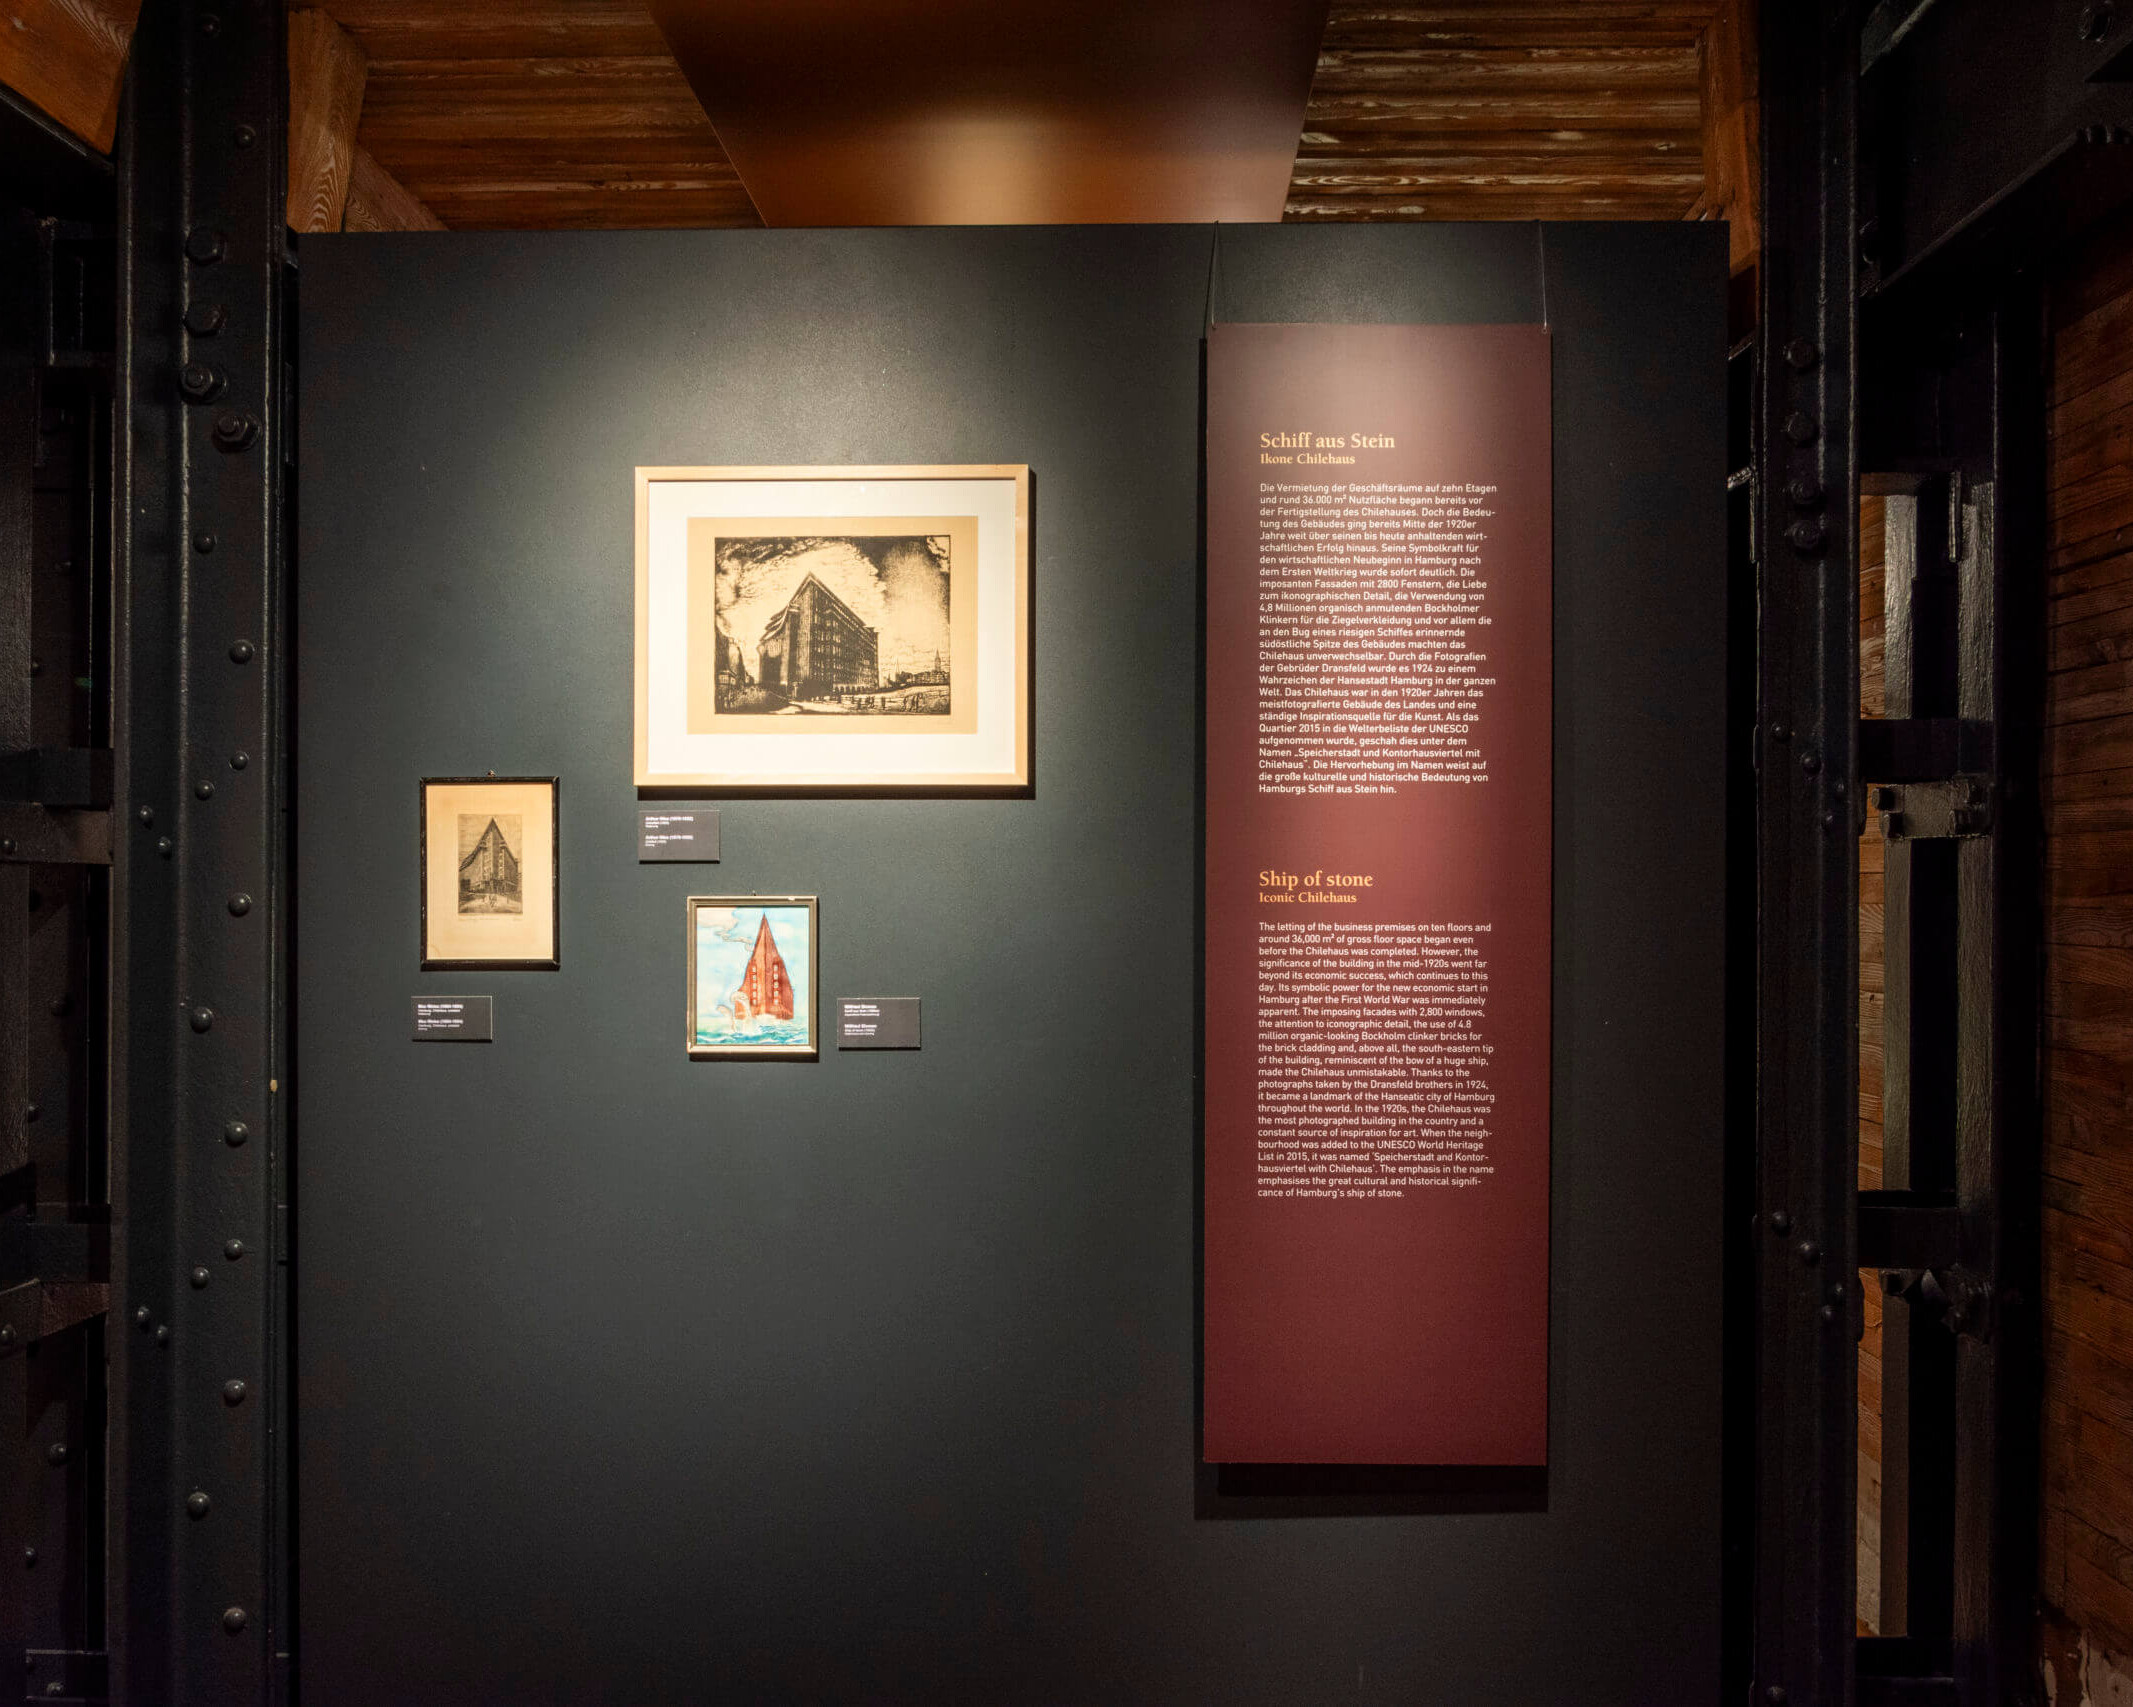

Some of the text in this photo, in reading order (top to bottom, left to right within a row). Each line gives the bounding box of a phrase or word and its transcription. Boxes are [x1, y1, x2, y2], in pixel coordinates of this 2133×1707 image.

[1260, 432, 1395, 448] Schiff aus Stein
[1260, 454, 1356, 465] Ikone Chilehaus
[1260, 483, 1497, 495] Die Vermietung der Geschäftsräume auf zehn Etagen
[1259, 507, 1275, 517] der
[1277, 507, 1341, 519] Fertigstellung
[1343, 507, 1359, 517] des
[1361, 507, 1418, 517] Chilehauses.
[1421, 507, 1444, 517] Doch
[1446, 507, 1460, 517] die
[1260, 531, 1286, 541] Jahre
[1287, 531, 1306, 541] weit
[1309, 531, 1330, 541] über
[1332, 531, 1362, 541] seinen
[1364, 531, 1377, 541] bis
[1379, 531, 1405, 541] heute
[1407, 531, 1464, 541] anhaltenden
[1259, 555, 1481, 567] den wirtschaftlichen Neubeginn in Hamburg nach
[1259, 579, 1487, 591] imposanten Fassaden mit 2800 Fenstern, die Liebe
[1275, 603, 1317, 613] Millionen
[1319, 603, 1363, 615] organisch
[1365, 603, 1422, 613] anmutenden
[1259, 640, 1466, 651] südöstliche Spitze des Gebäudes machten das
[1259, 664, 1275, 673] der
[1277, 664, 1319, 673] Gebrüder
[1322, 664, 1366, 673] Dransfeld
[1368, 664, 1397, 673] wurde
[1413, 664, 1433, 673] 1924
[1448, 664, 1476, 673] einem
[1259, 676, 1496, 688] Wahrzeichen der Hansestadt Hamburg in der ganzen
[1259, 724, 1469, 733] Quartier 2015 in die Welterbeliste der UNESCO
[1259, 870, 1373, 891] Ship of stone
[1259, 892, 1357, 903] Iconic Chilehaus
[1259, 923, 1275, 932] The
[1277, 923, 1305, 934] letting
[1307, 923, 1316, 932] of
[1318, 923, 1332, 932] the
[1334, 923, 1373, 932] business
[1375, 923, 1416, 934] premises
[1431, 923, 1445, 932] ten
[1447, 923, 1473, 932] floors
[1474, 923, 1492, 932] and
[1258, 947, 1287, 956] before
[1289, 947, 1303, 956] the
[1305, 947, 1349, 956] Chilehaus
[1370, 947, 1419, 959] completed.
[1421, 947, 1462, 956] However,
[1464, 947, 1479, 956] the
[1259, 959, 1488, 971] significance of the building in the mid-1920s went far
[1258, 1007, 1485, 1019] apparent. The imposing facades with 2,800 windows,
[1258, 1031, 1482, 1043] million organic-looking Bockholm clinker bricks for
[1258, 1080, 1489, 1092] photographs taken by the Dransfeld brothers in 1924,
[1258, 1092, 1264, 1101] it
[1266, 1092, 1301, 1101] became
[1310, 1092, 1352, 1101] landmark
[1354, 1092, 1363, 1101] of
[1365, 1092, 1379, 1101] the
[1381, 1092, 1424, 1101] Hanseatic
[1426, 1092, 1442, 1104] city
[1443, 1092, 1452, 1101] of
[1454, 1092, 1495, 1104] Hamburg
[1258, 1116, 1272, 1125] the
[1274, 1116, 1296, 1125] most
[1298, 1116, 1359, 1128] photographed
[1361, 1116, 1396, 1128] building
[1398, 1116, 1407, 1125] in
[1408, 1116, 1423, 1125] the
[1425, 1116, 1458, 1128] country
[1460, 1116, 1477, 1125] and
[1257, 1190, 1284, 1198] cance
[1285, 1188, 1294, 1198] of
[1346, 1188, 1366, 1200] ship
[1367, 1188, 1376, 1198] of
[1377, 1188, 1404, 1198] stone.
